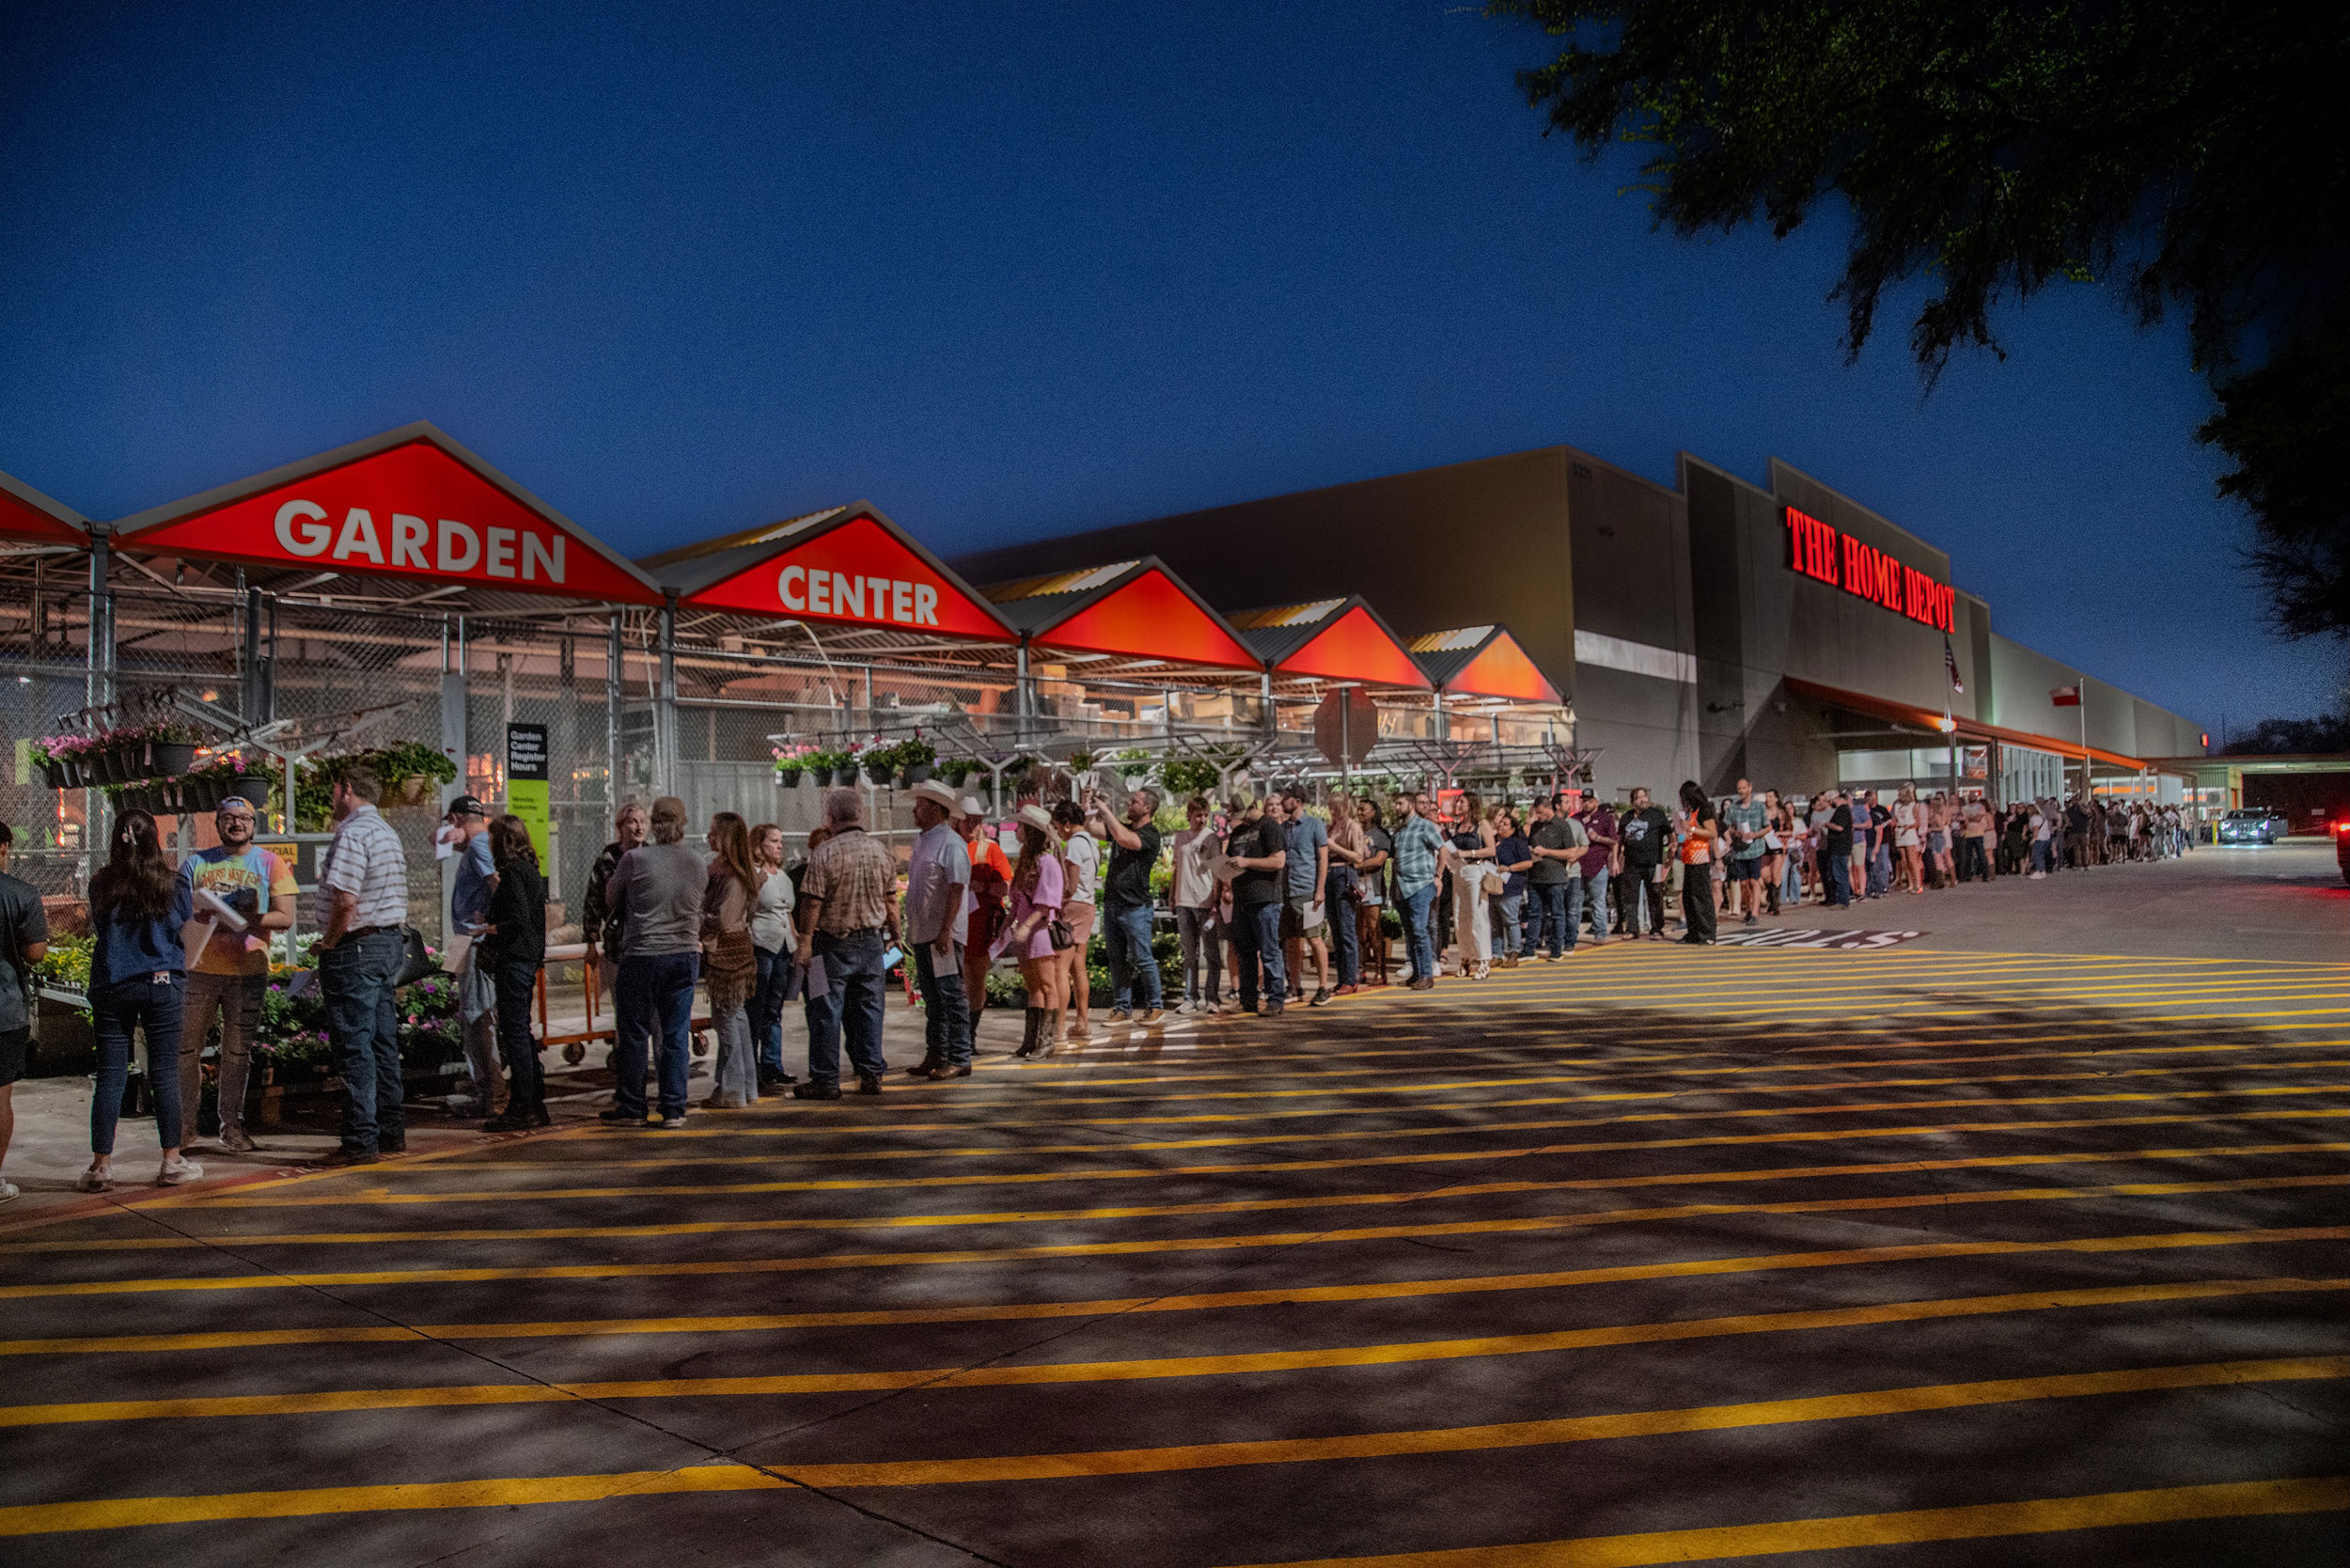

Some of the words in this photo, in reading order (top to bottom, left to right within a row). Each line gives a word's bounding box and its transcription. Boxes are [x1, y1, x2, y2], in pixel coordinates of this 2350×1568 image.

[274, 499, 566, 584] GARDEN
[1787, 506, 1838, 586] THE
[1842, 533, 1902, 611] HOME
[1904, 566, 1955, 634] DEPOT
[777, 565, 939, 626] CENTER
[510, 730, 542, 741] Garden
[510, 741, 540, 751] Center
[510, 751, 546, 762] Register
[510, 761, 538, 772] Hours
